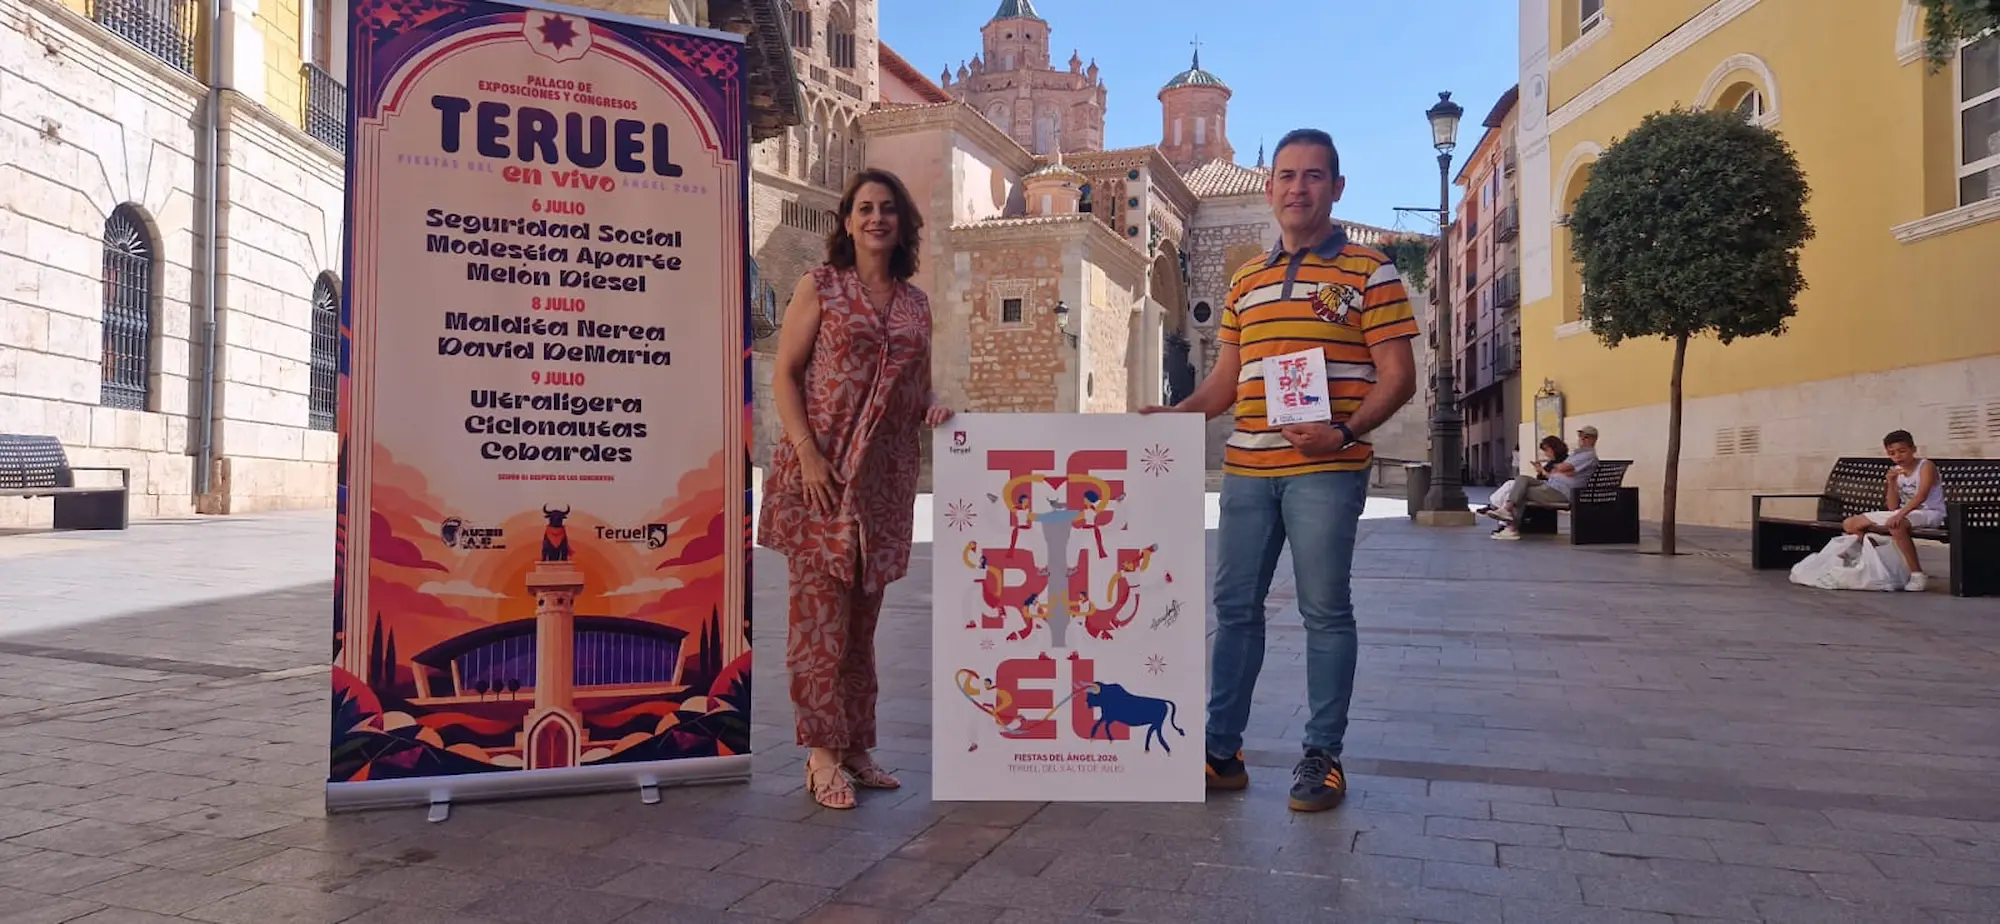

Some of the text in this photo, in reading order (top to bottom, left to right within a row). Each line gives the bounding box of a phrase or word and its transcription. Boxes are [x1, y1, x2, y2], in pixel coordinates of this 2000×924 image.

[478, 80, 637, 111] EXPOSICIONES Y CONGRESOS
[527, 75, 592, 93] PALACIO DE
[431, 95, 683, 178] TERUEL
[503, 165, 616, 192] en vivo
[532, 200, 586, 216] 6 JULIO
[426, 208, 682, 248] Seguridad Social
[426, 234, 682, 271] Modestia Aparte
[559, 269, 646, 293] Diesel
[532, 296, 585, 312] 8 JULIO
[445, 311, 666, 341] Maldita Nerea
[438, 336, 534, 360] David
[531, 371, 585, 386] 9 JULIO
[471, 389, 642, 415] Ultraligera
[465, 415, 647, 438] Ciclonautas
[480, 441, 632, 462] Cobardes
[595, 524, 646, 539] Teruel
[1014, 753, 1048, 762] FIESTAS
[1050, 753, 1064, 762] DEL
[1067, 752, 1096, 762] ÁNGEL
